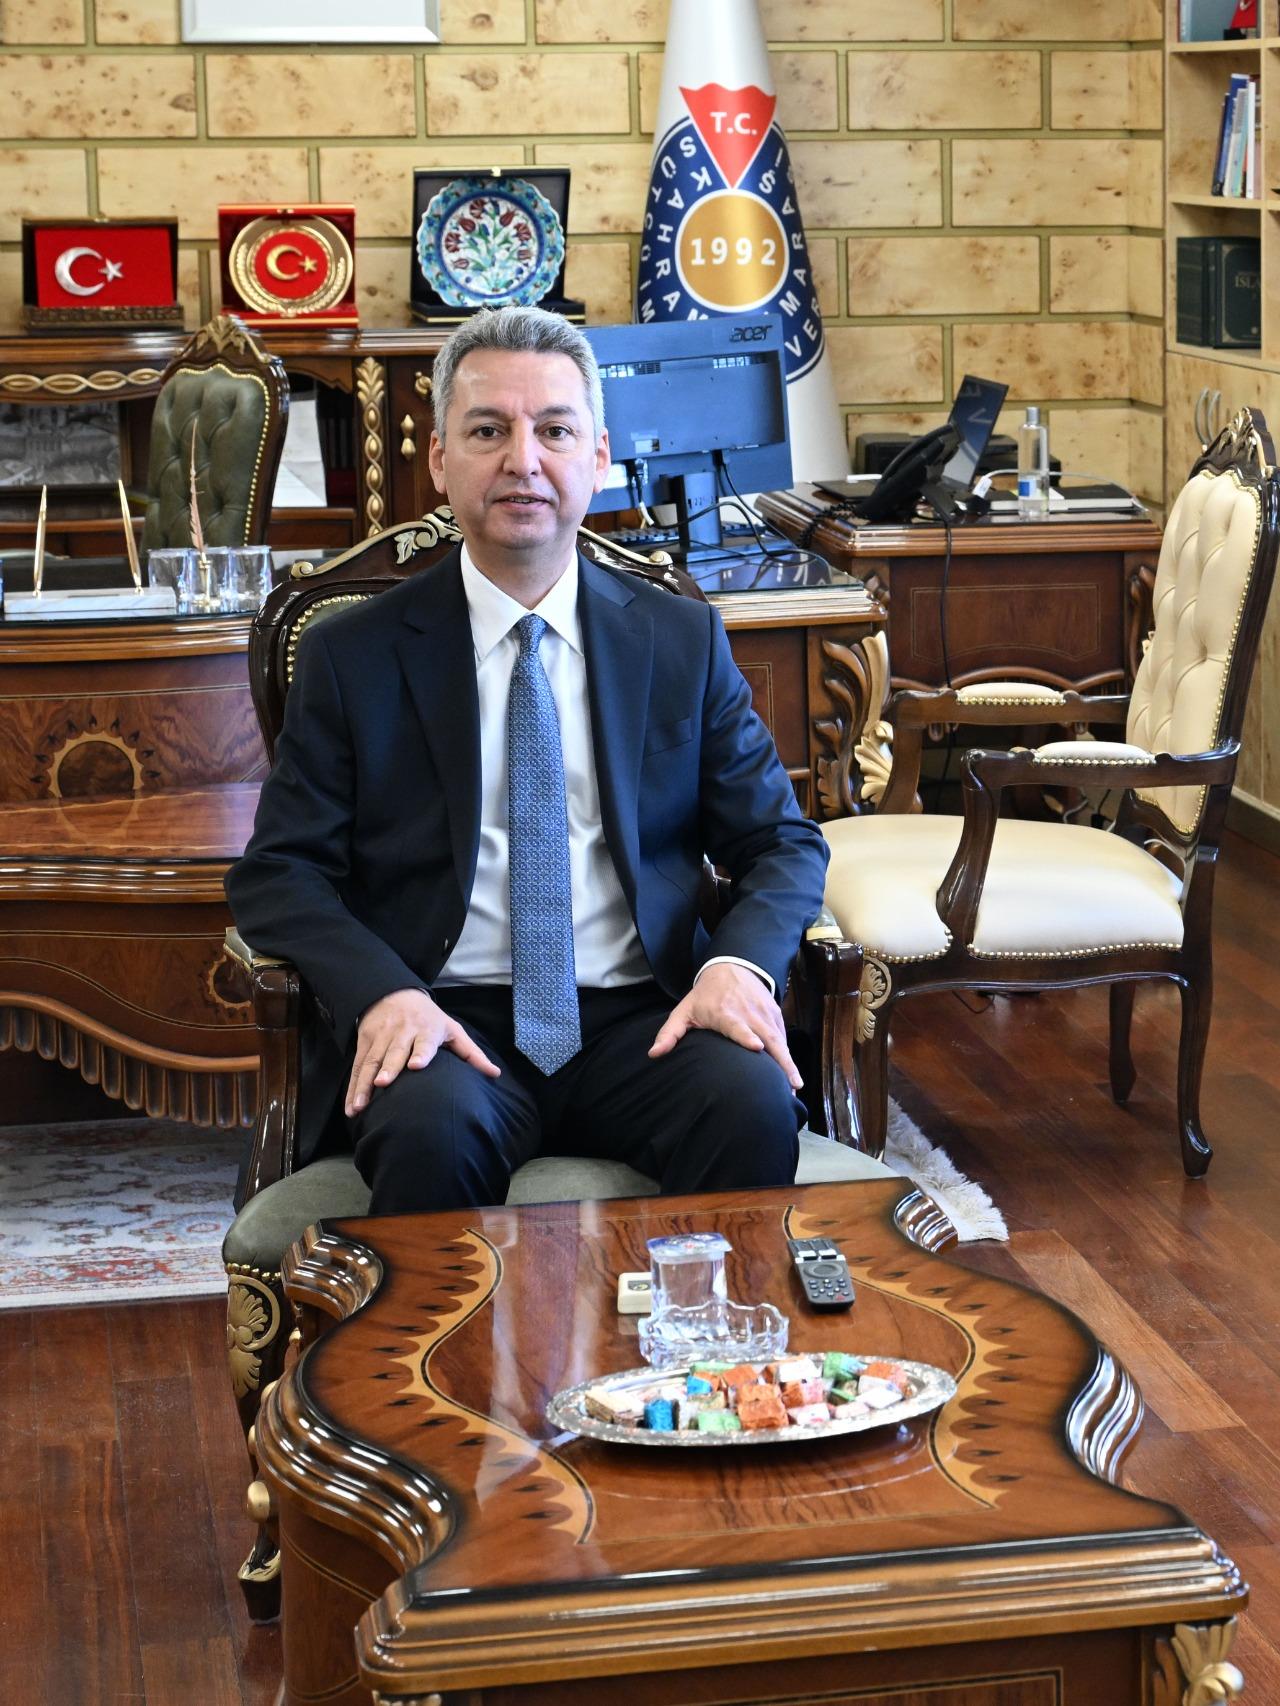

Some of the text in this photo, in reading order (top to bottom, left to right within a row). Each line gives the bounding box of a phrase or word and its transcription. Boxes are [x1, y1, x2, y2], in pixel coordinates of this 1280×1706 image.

[710, 112, 758, 136] T.C.
[690, 237, 777, 267] 1992
[729, 325, 773, 342] acer
